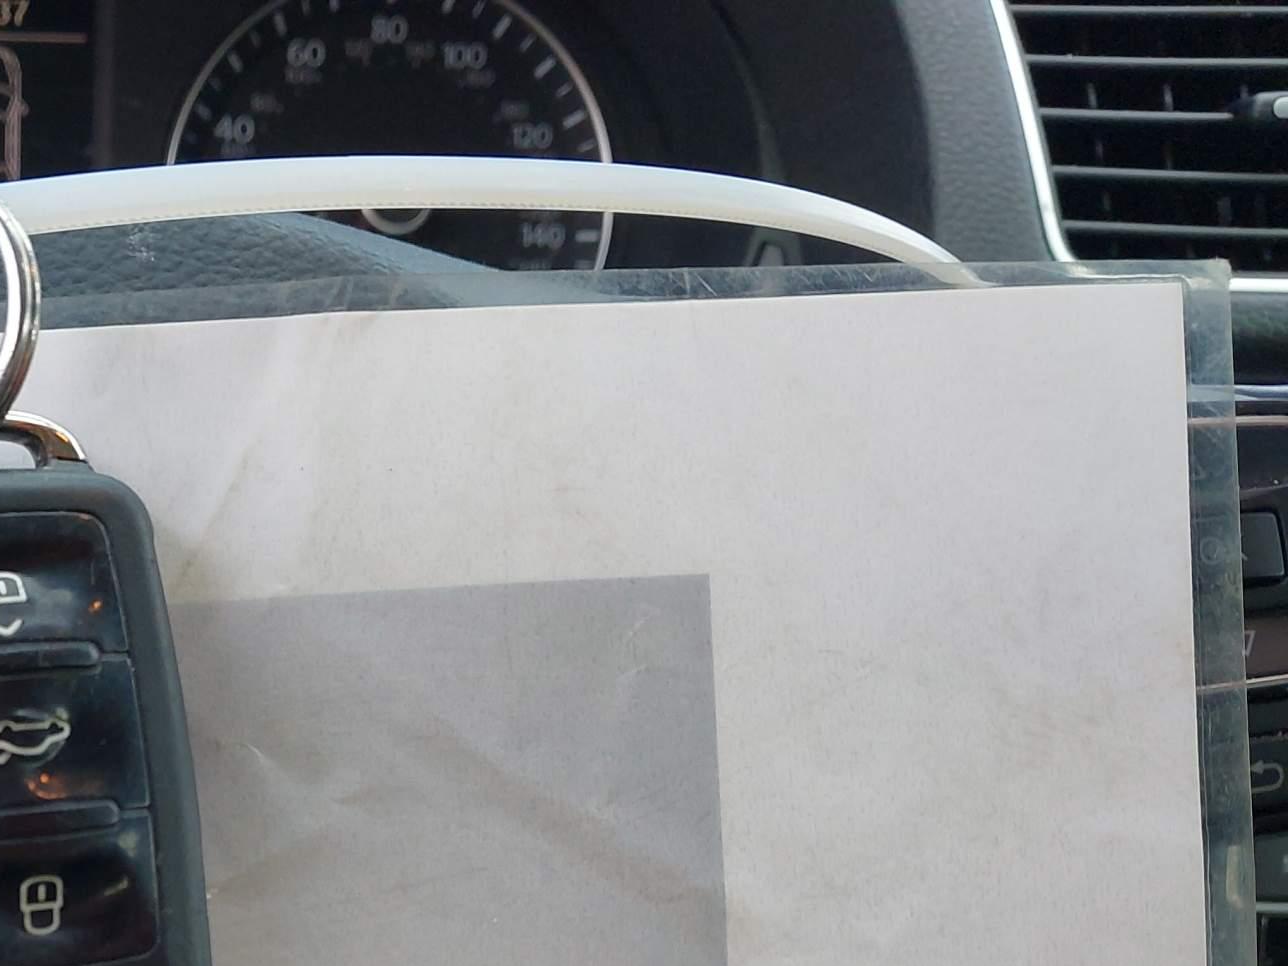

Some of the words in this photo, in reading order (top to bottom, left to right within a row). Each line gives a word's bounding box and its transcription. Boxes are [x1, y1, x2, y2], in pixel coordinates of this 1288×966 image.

[370, 16, 409, 43] 80
[286, 39, 326, 69] 60
[443, 41, 488, 70] 100
[214, 114, 255, 144] 40
[512, 123, 554, 149] 120
